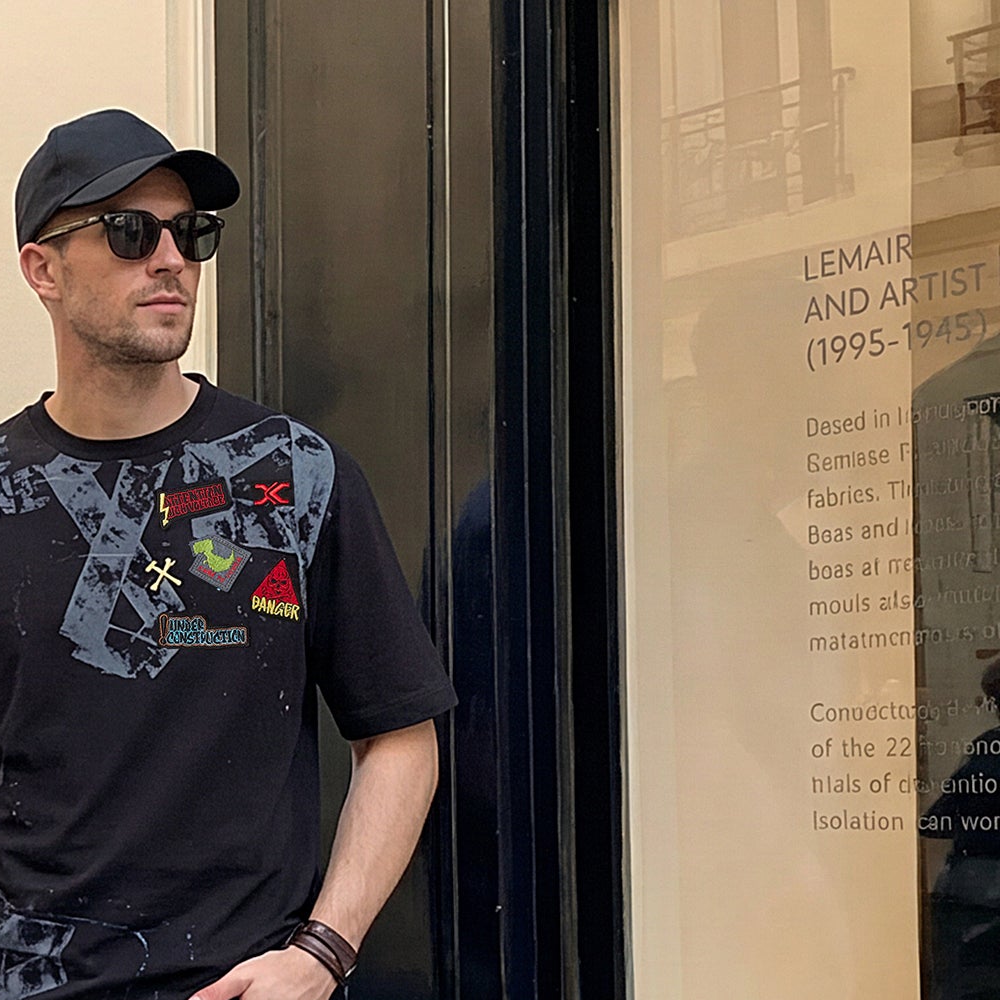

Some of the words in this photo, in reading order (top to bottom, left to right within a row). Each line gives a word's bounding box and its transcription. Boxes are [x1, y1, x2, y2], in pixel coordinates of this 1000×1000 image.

[804, 287, 870, 324] AND
[879, 262, 986, 310] ARTIST
[807, 307, 987, 372] (1995-1945)
[873, 409, 890, 429] in
[861, 517, 899, 540] and
[809, 559, 854, 581] boas
[251, 595, 301, 621] DANGER
[811, 738, 833, 759] of
[842, 737, 876, 759] the
[886, 737, 913, 758] 22
[869, 772, 892, 794] of
[812, 809, 905, 832] Isolation
[918, 814, 953, 831] can
